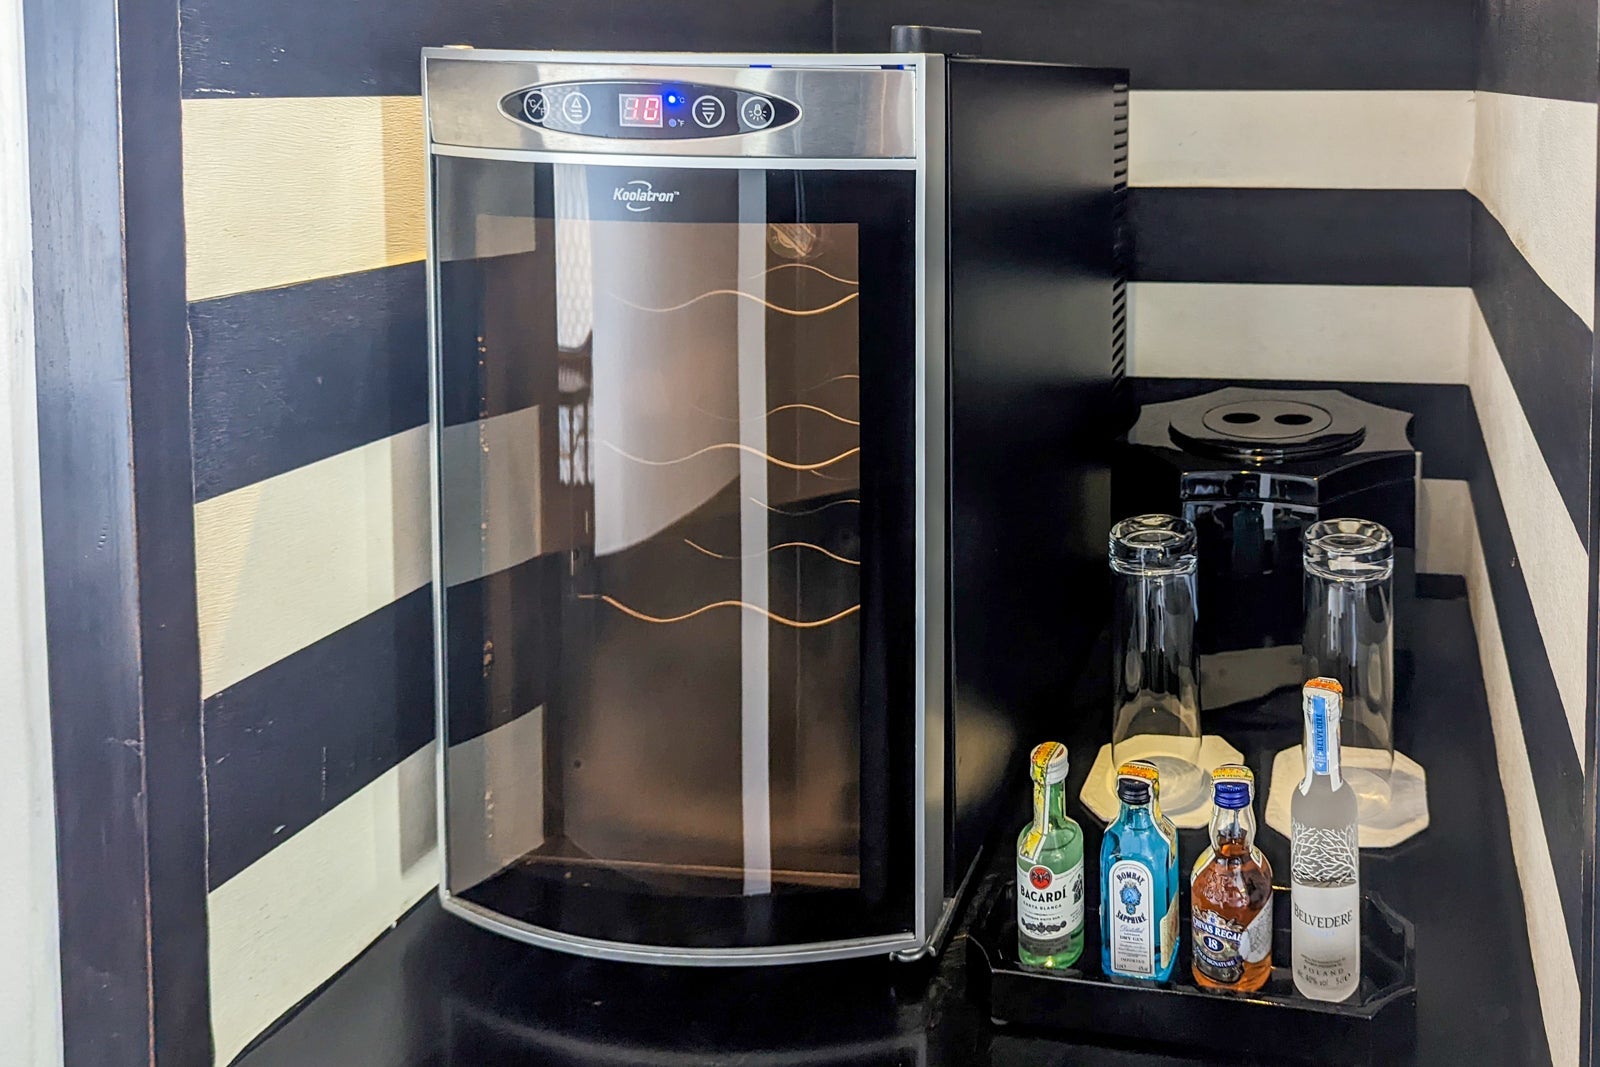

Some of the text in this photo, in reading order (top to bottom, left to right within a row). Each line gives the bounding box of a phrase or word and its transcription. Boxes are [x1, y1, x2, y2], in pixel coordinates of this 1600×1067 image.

[632, 97, 659, 121] 10
[1116, 871, 1145, 886] BOMBAY
[1020, 884, 1067, 903] BACARDÍ
[1116, 910, 1147, 924] SAPPHIRE
[1294, 903, 1353, 929] BELVEDERE
[1207, 937, 1219, 950] 18
